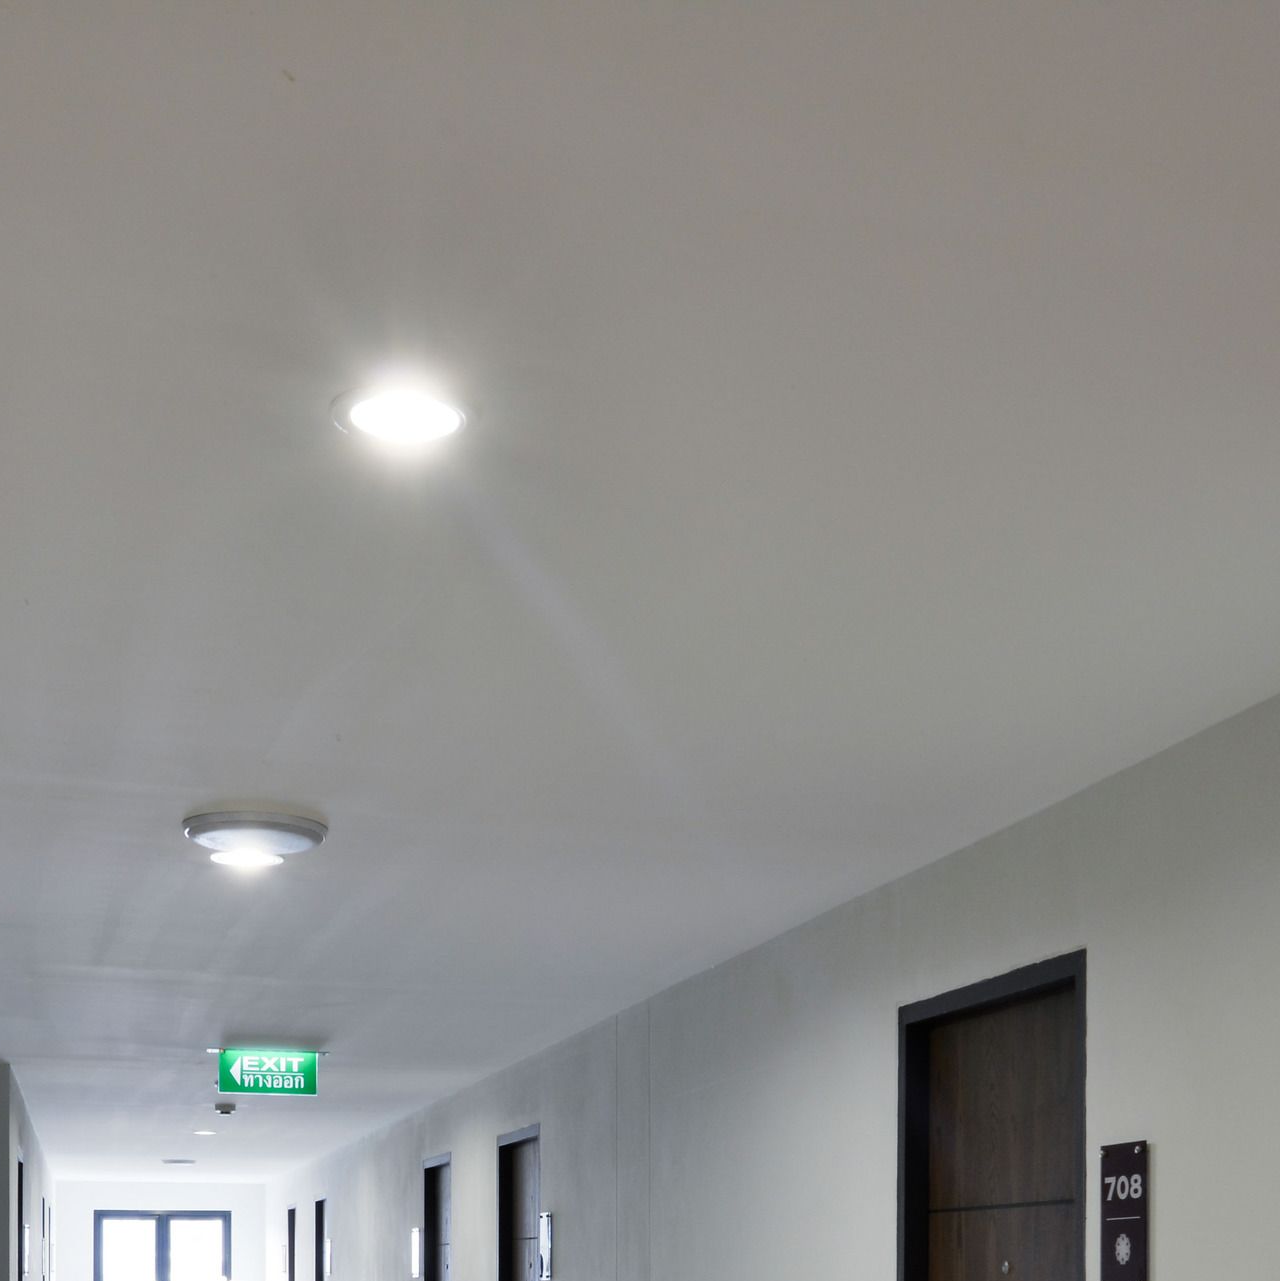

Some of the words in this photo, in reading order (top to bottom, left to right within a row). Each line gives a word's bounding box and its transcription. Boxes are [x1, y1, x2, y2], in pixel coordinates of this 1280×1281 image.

[242, 1056, 305, 1073] EXIT
[242, 1074, 305, 1089] ทางออก
[1104, 1174, 1143, 1201] 708
